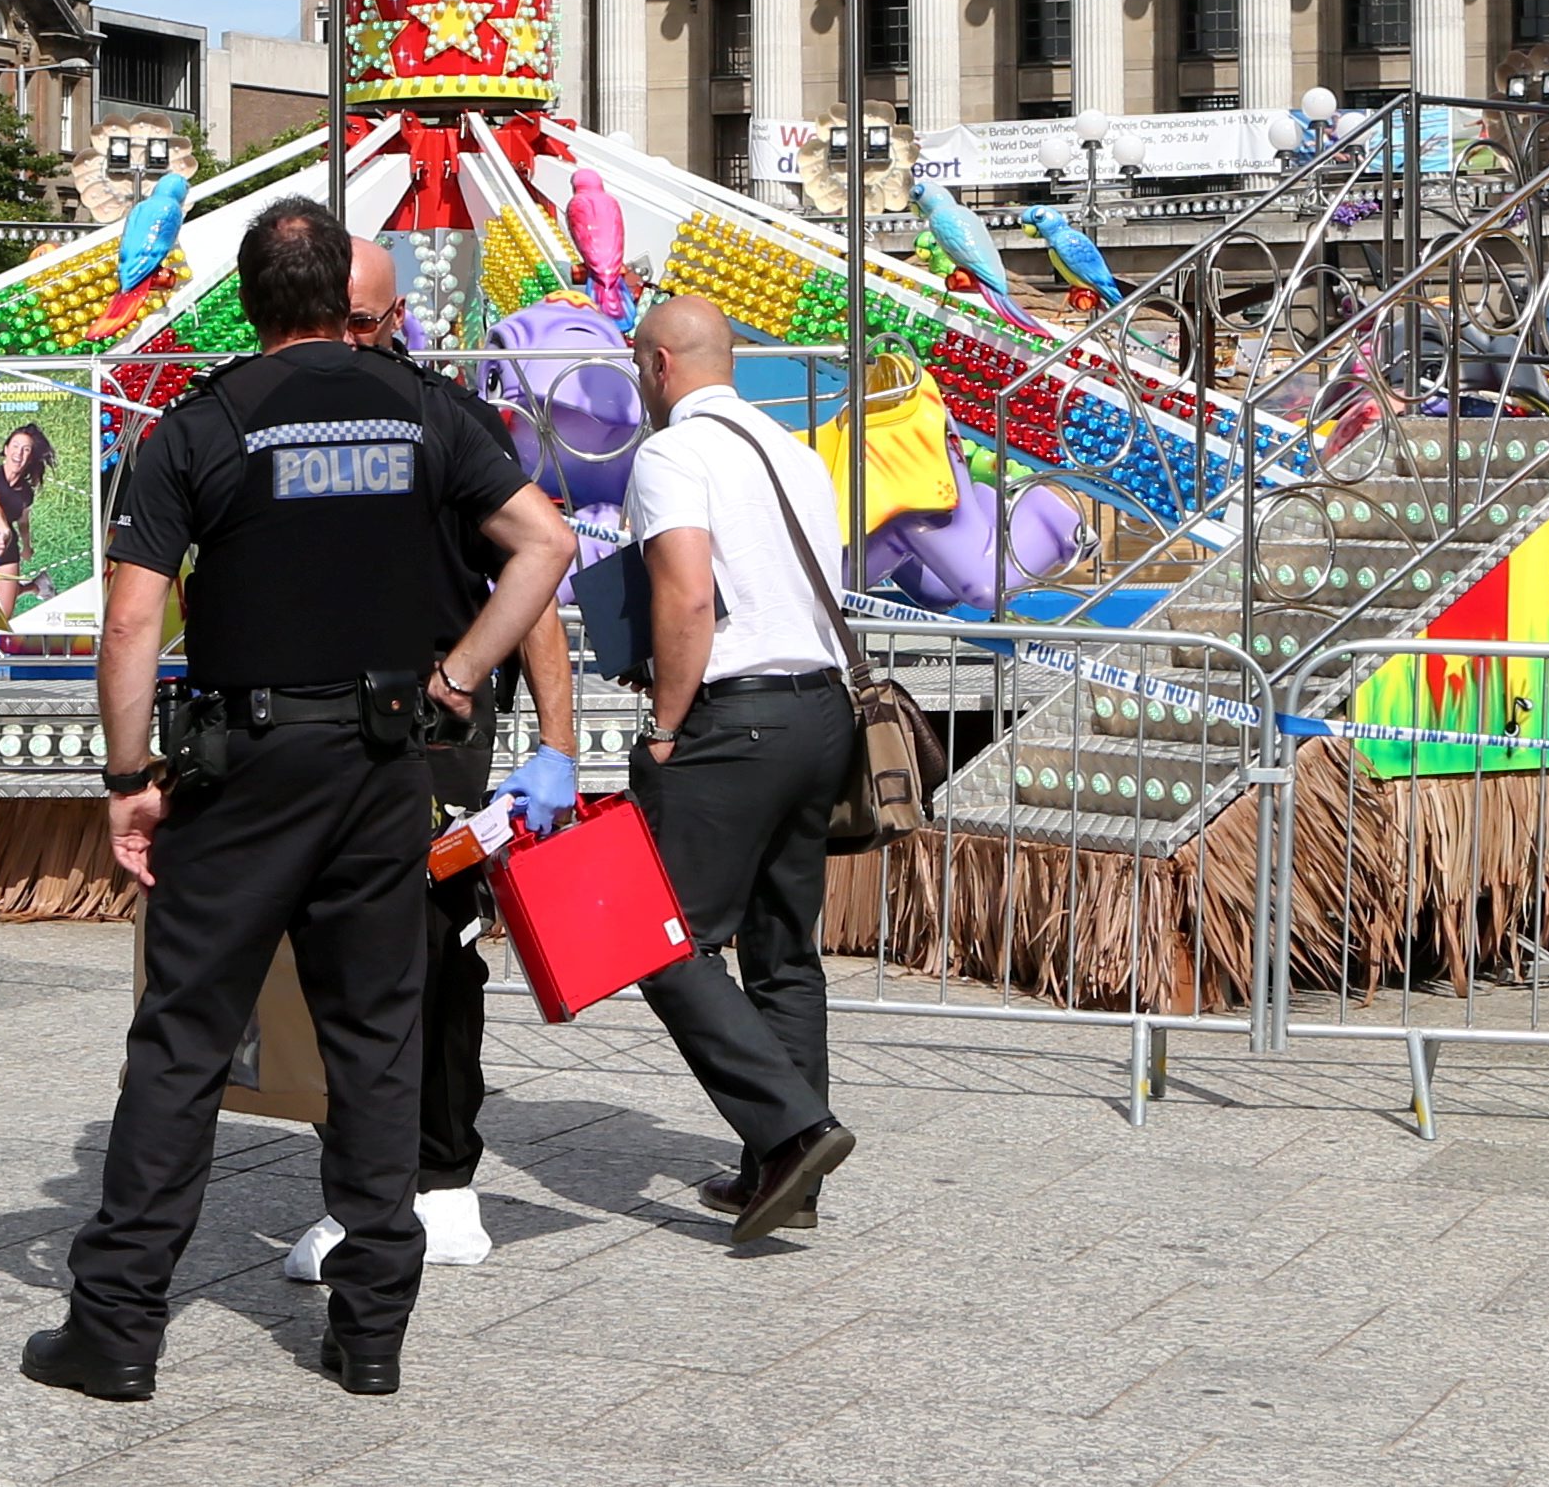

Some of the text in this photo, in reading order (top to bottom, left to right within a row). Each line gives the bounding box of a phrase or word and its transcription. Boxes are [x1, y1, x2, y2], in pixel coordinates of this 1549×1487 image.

[989, 126, 1019, 137] British
[1022, 125, 1048, 137] Open
[1140, 118, 1219, 130] Championships,
[990, 140, 1017, 151] World
[1020, 139, 1041, 149] Deaf
[1192, 132, 1209, 143] July
[1178, 161, 1213, 172] Games,
[0, 392, 70, 402] COMMUNITY
[0, 401, 39, 412] TENNIS
[278, 444, 409, 495] POLICE
[572, 520, 620, 543] ROSS
[1090, 660, 1128, 687] LINE
[1163, 683, 1196, 706] NOT
[1343, 722, 1404, 741] POLICE
